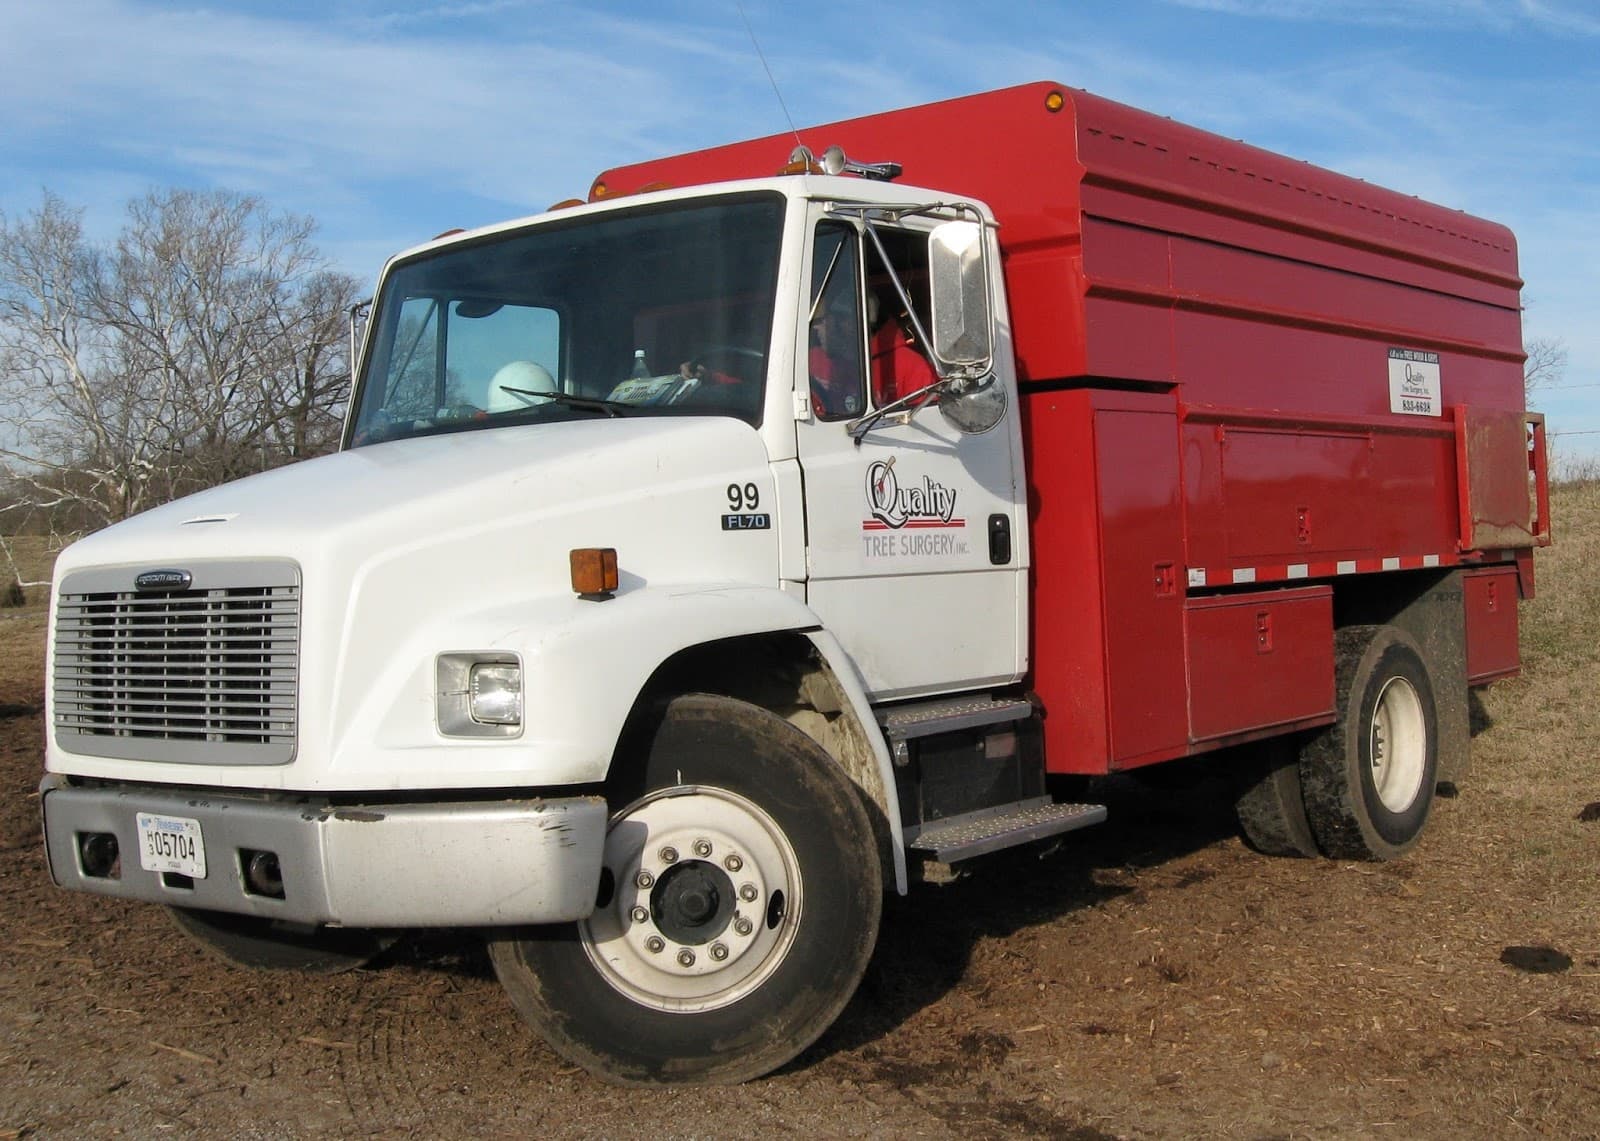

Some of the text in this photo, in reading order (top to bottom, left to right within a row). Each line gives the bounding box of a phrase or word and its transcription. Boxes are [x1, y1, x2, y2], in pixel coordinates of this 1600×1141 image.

[1405, 363, 1425, 386] Quality
[727, 482, 759, 511] 99
[864, 461, 957, 530] Quality
[727, 515, 765, 529] FL70
[863, 535, 896, 558] TREE
[154, 831, 195, 862] 05704
